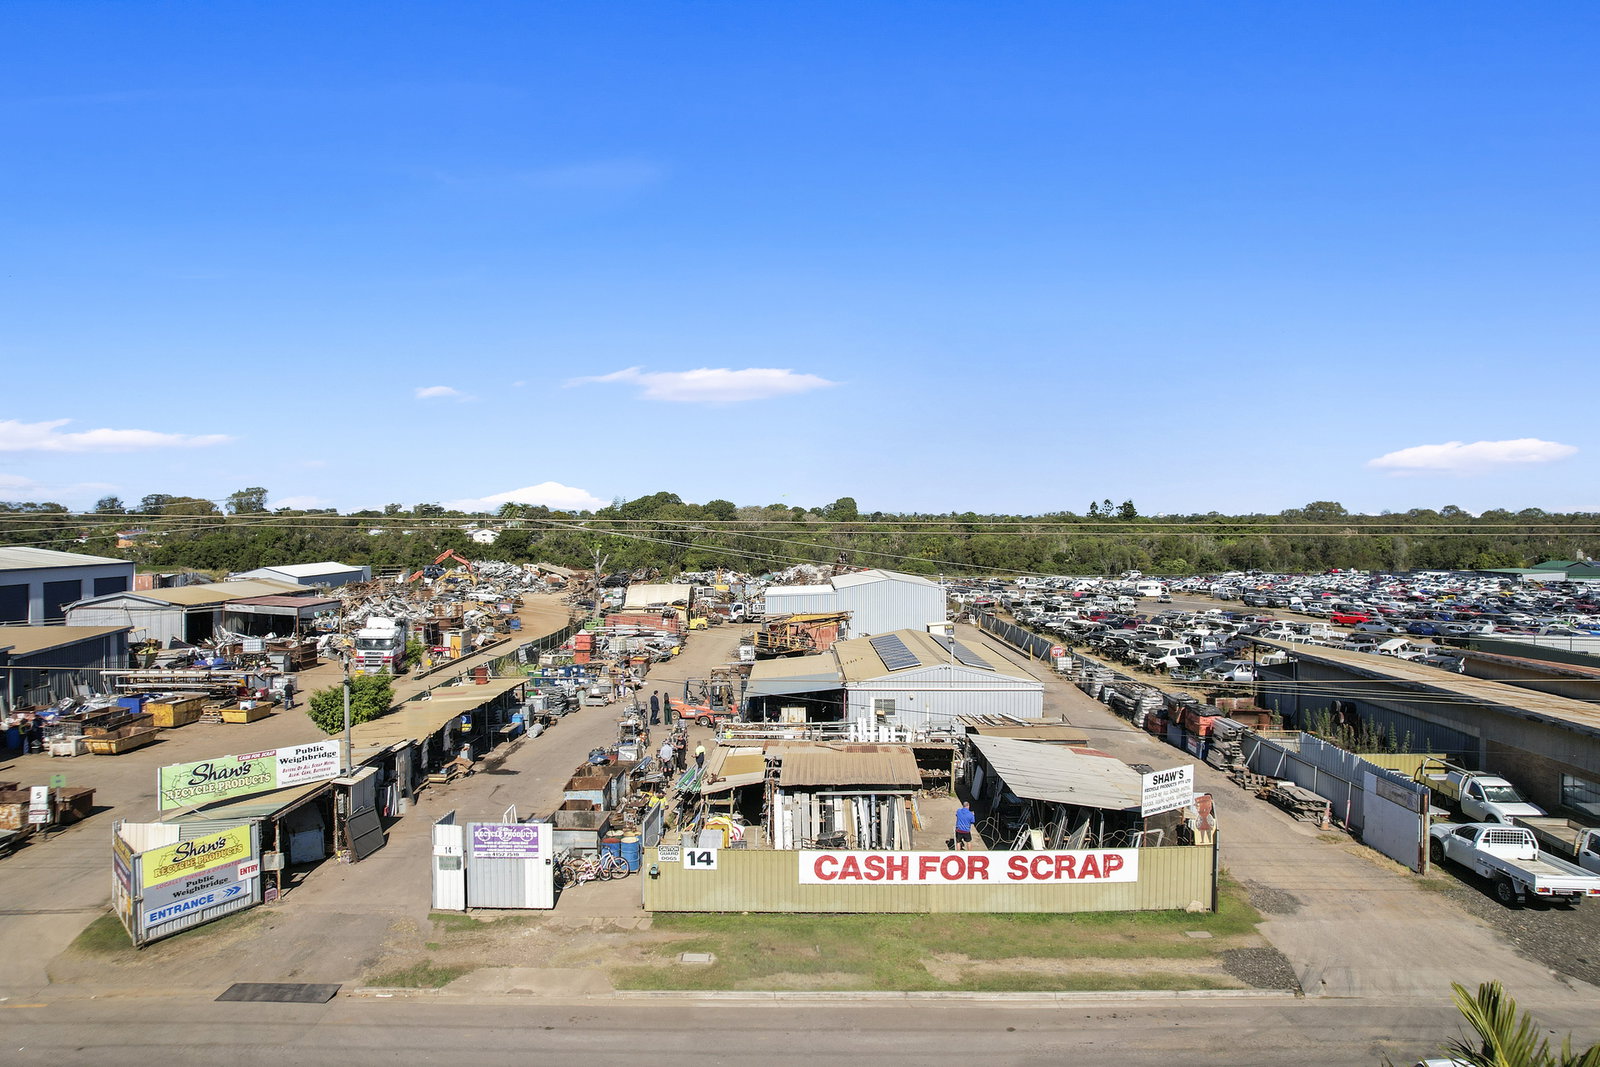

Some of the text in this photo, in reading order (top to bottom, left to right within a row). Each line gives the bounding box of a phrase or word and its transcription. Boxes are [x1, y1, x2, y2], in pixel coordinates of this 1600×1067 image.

[279, 751, 336, 764] Weighbridge
[296, 746, 324, 755] Public
[188, 762, 252, 786] Shaw's
[1153, 770, 1184, 785] SHAW'S
[166, 773, 271, 800] RECYCLE PRODUCTS
[172, 837, 226, 863] Shaw's
[687, 851, 714, 866] 14
[154, 858, 196, 878] RECYCLE
[197, 844, 243, 865] PRODUCTS
[240, 864, 258, 876] ENTRY
[814, 854, 1123, 880] CASH FOR SCRAP
[173, 877, 228, 898] Weighbridge
[186, 875, 214, 887] Public
[150, 894, 214, 922] ENTRANCE
